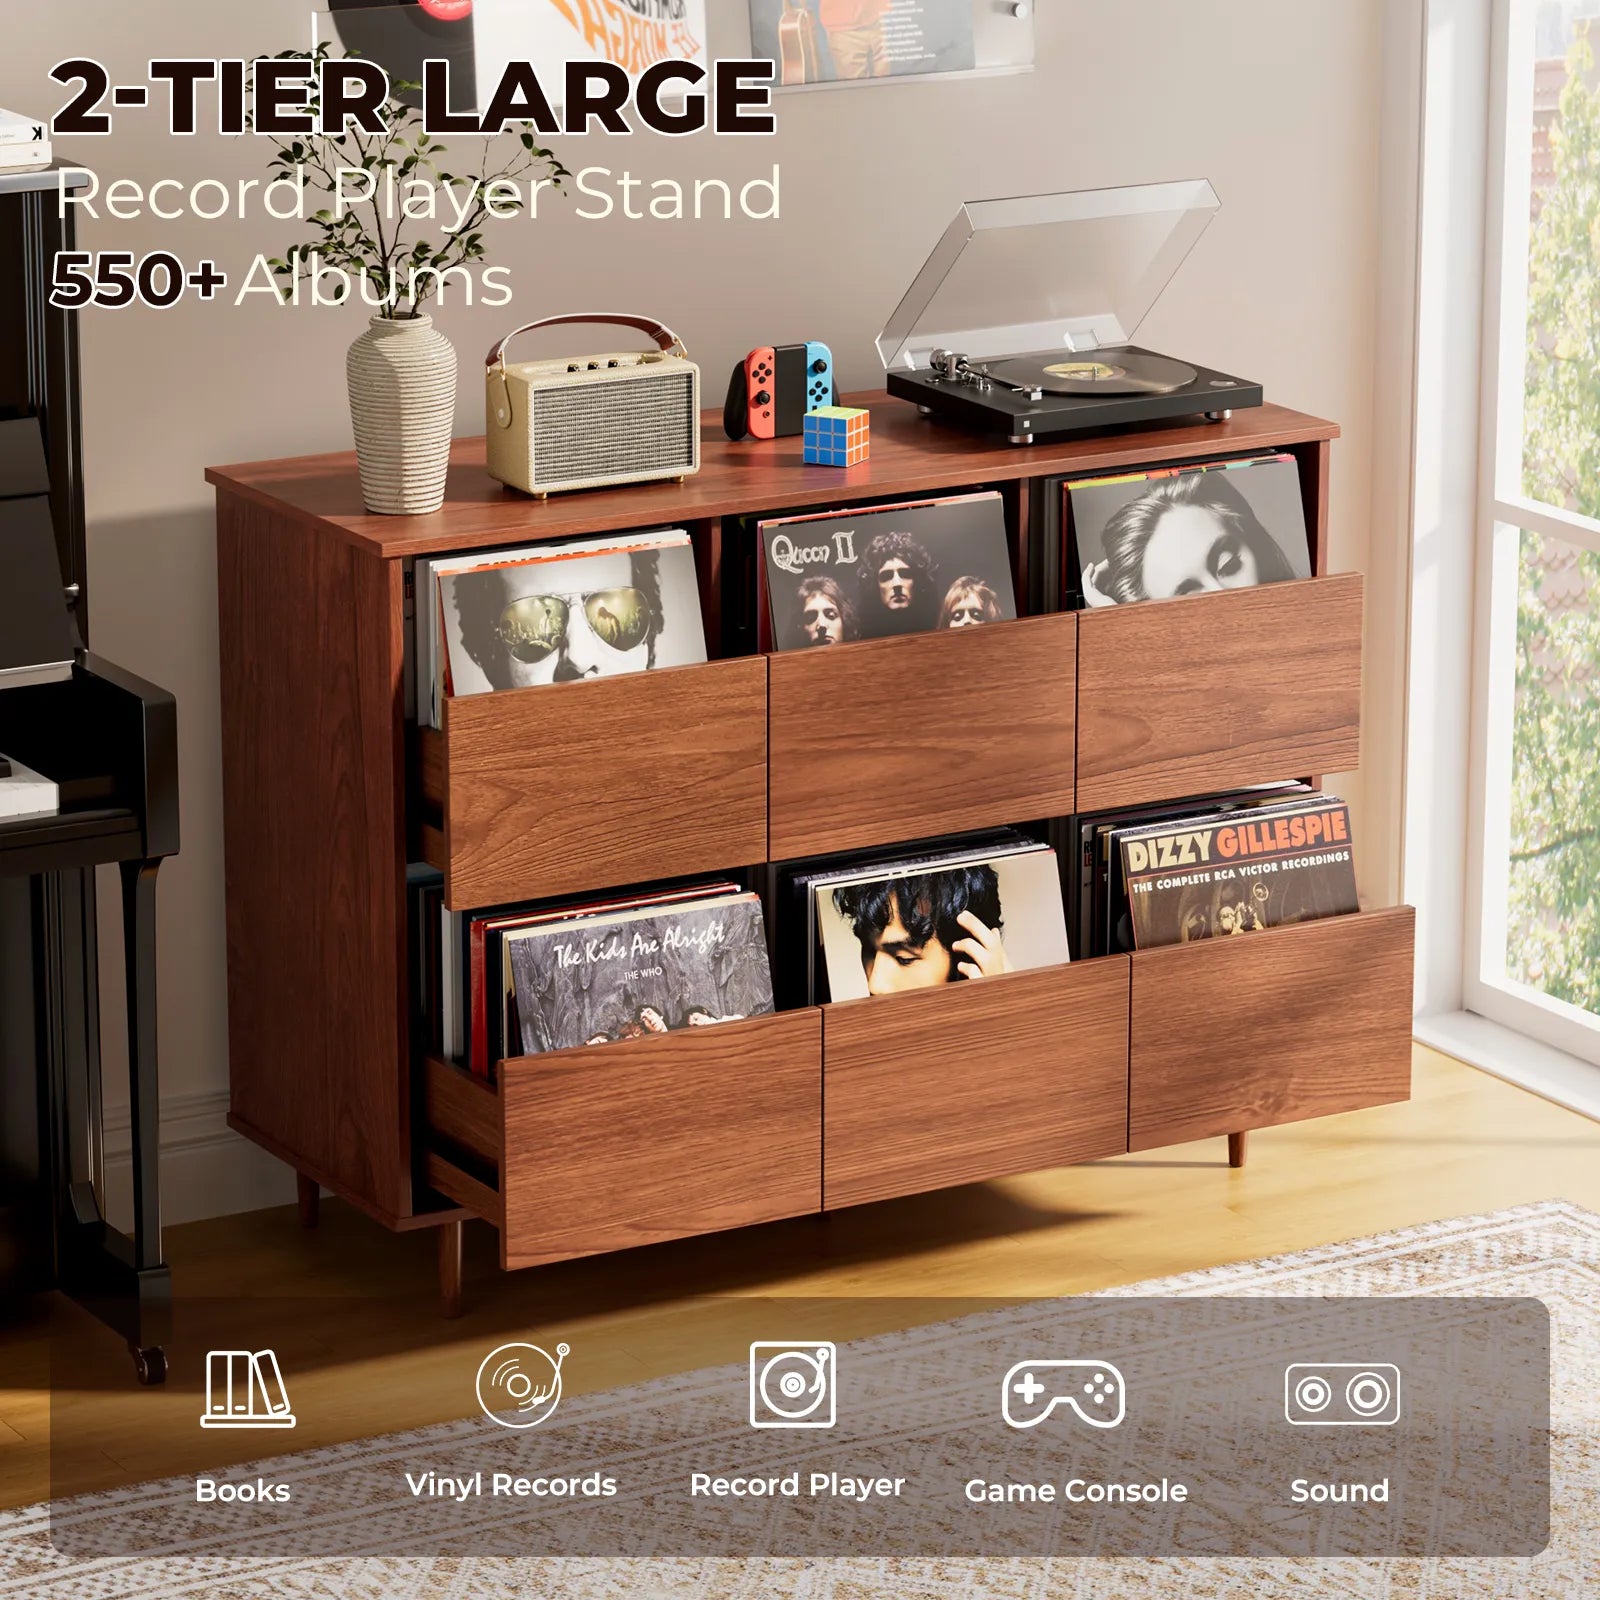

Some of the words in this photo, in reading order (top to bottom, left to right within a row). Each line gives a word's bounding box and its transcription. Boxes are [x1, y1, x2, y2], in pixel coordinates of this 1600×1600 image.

[771, 534, 830, 574] Queen
[1127, 830, 1213, 872] DIZZY
[1217, 810, 1348, 858] GILLESPIE
[1132, 881, 1153, 893] THE
[1156, 872, 1211, 890] COMPLETE
[1214, 869, 1236, 881] RCA
[1239, 862, 1279, 877] VICTOR
[1282, 851, 1350, 870] RECORDINGS
[553, 944, 582, 968] The
[586, 936, 627, 963] Kids
[631, 931, 660, 958] Are
[663, 920, 725, 953] Alright
[624, 971, 639, 981] THE
[640, 966, 663, 979] WHO
